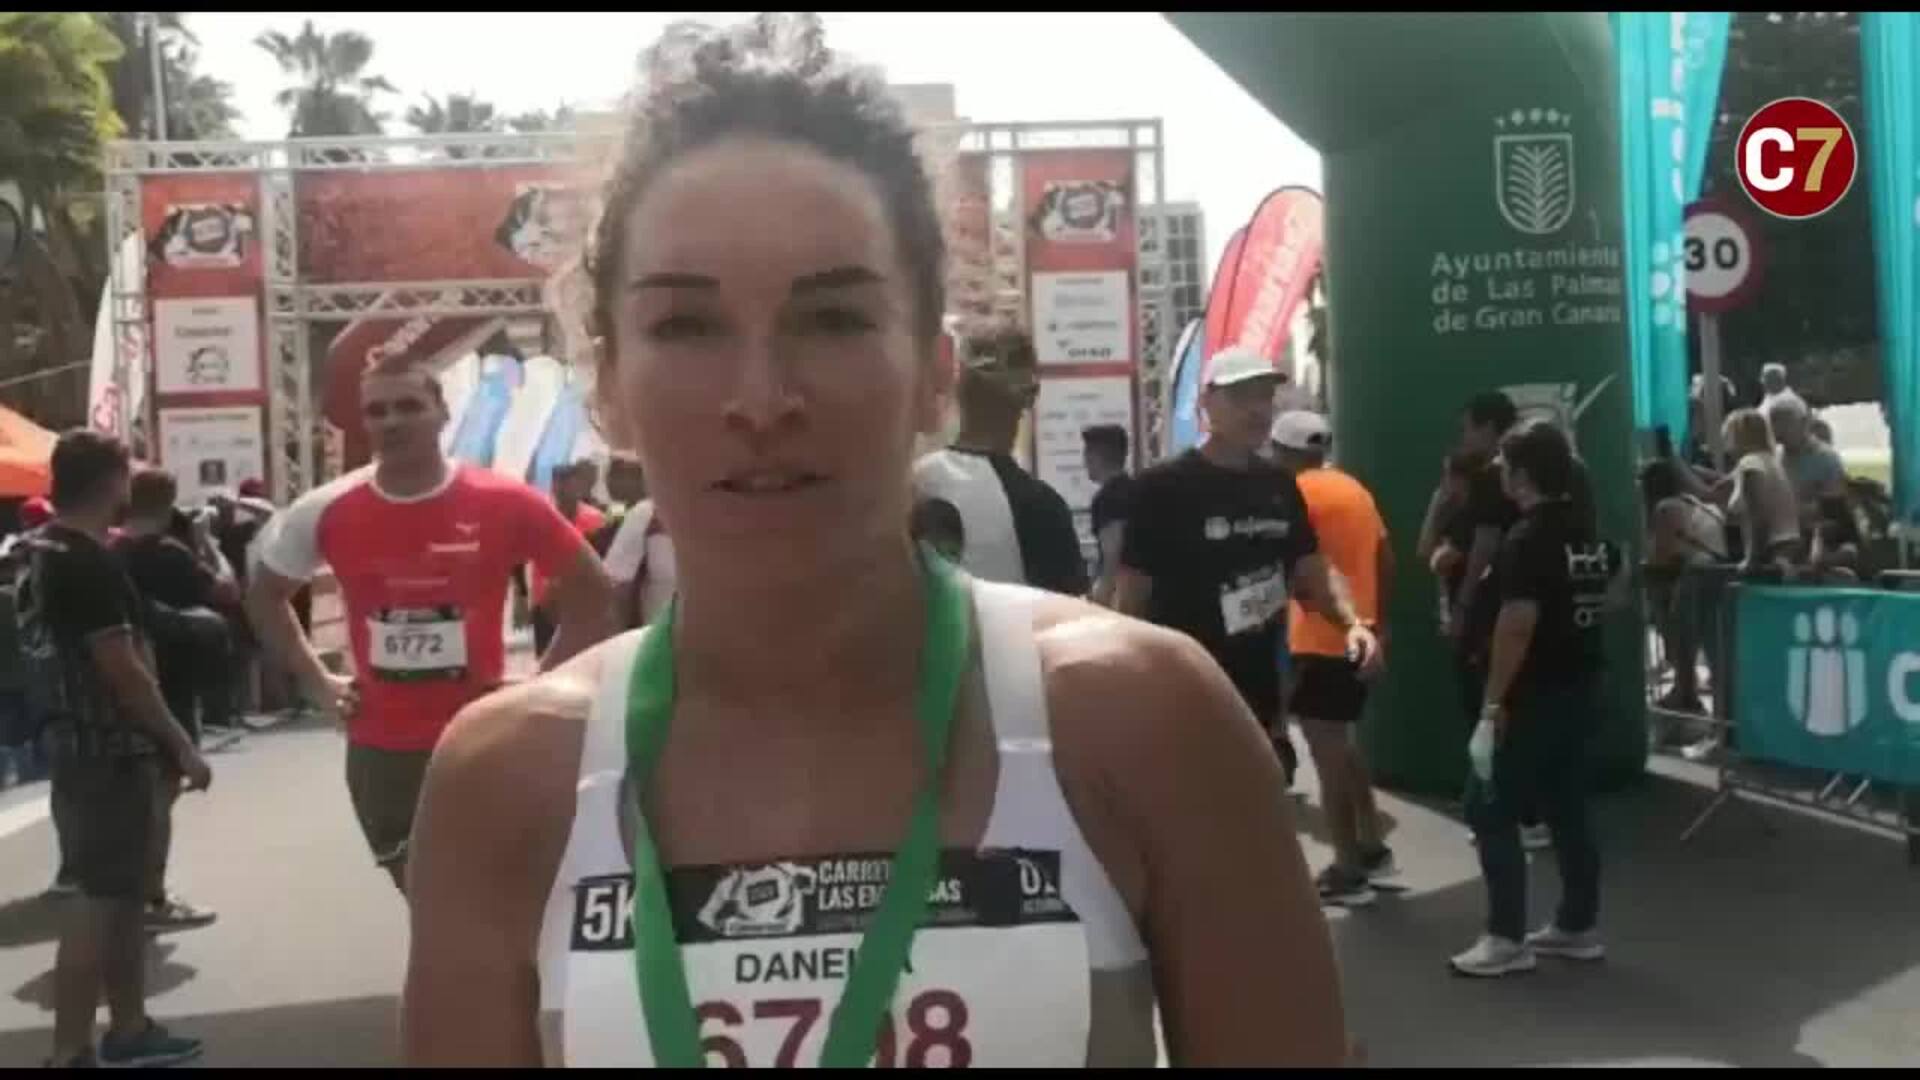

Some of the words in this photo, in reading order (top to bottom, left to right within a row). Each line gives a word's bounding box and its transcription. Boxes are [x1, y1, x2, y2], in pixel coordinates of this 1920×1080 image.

[1684, 237, 1740, 271] 30
[1432, 279, 1468, 304] de
[1487, 274, 1535, 300] Las
[1551, 272, 1621, 296] Palma
[1432, 308, 1466, 334] de
[1475, 304, 1543, 330] Gran
[384, 633, 443, 655] 6772
[818, 885, 856, 911] LAS
[696, 989, 973, 1068] 678
